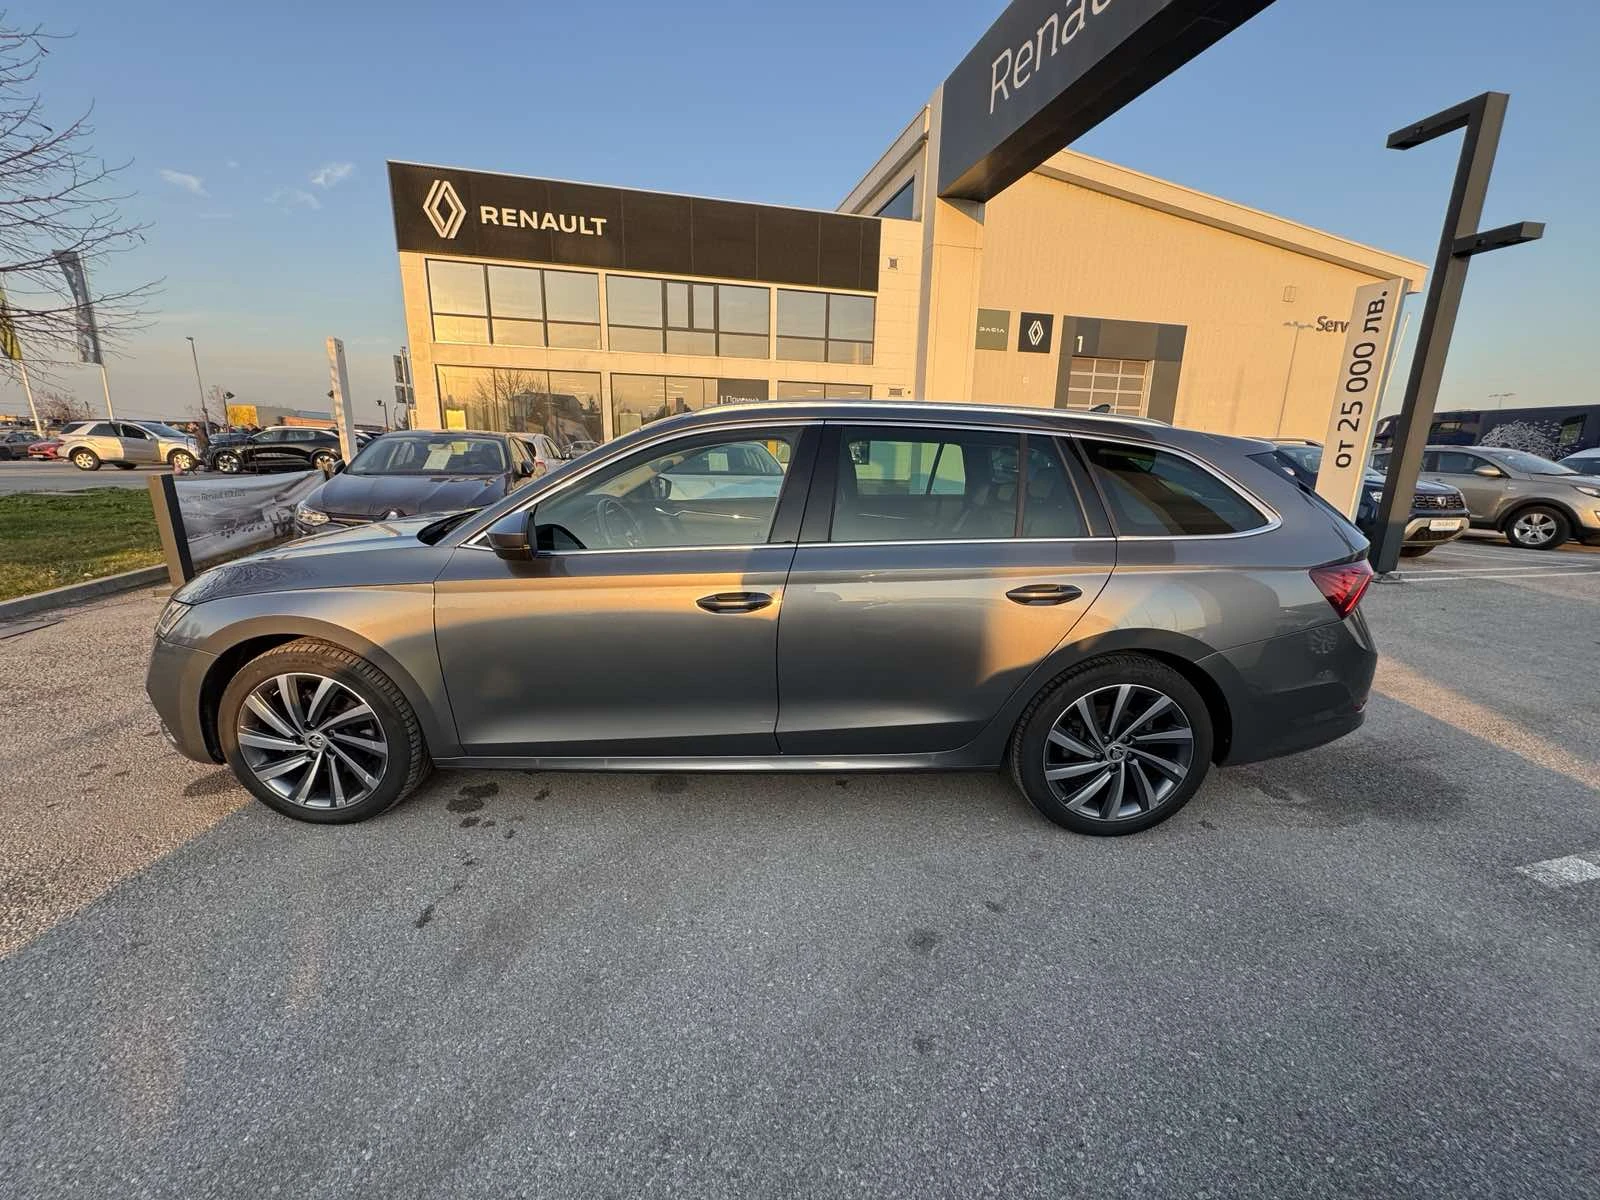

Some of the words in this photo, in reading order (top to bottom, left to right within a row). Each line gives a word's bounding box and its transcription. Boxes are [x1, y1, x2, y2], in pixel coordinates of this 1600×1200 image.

[480, 205, 607, 236] RENAULT
[1363, 290, 1388, 333] лв.
[1077, 335, 1084, 353] 1
[1346, 342, 1376, 393] 000
[1337, 401, 1363, 432] 25
[1335, 440, 1354, 468] от
